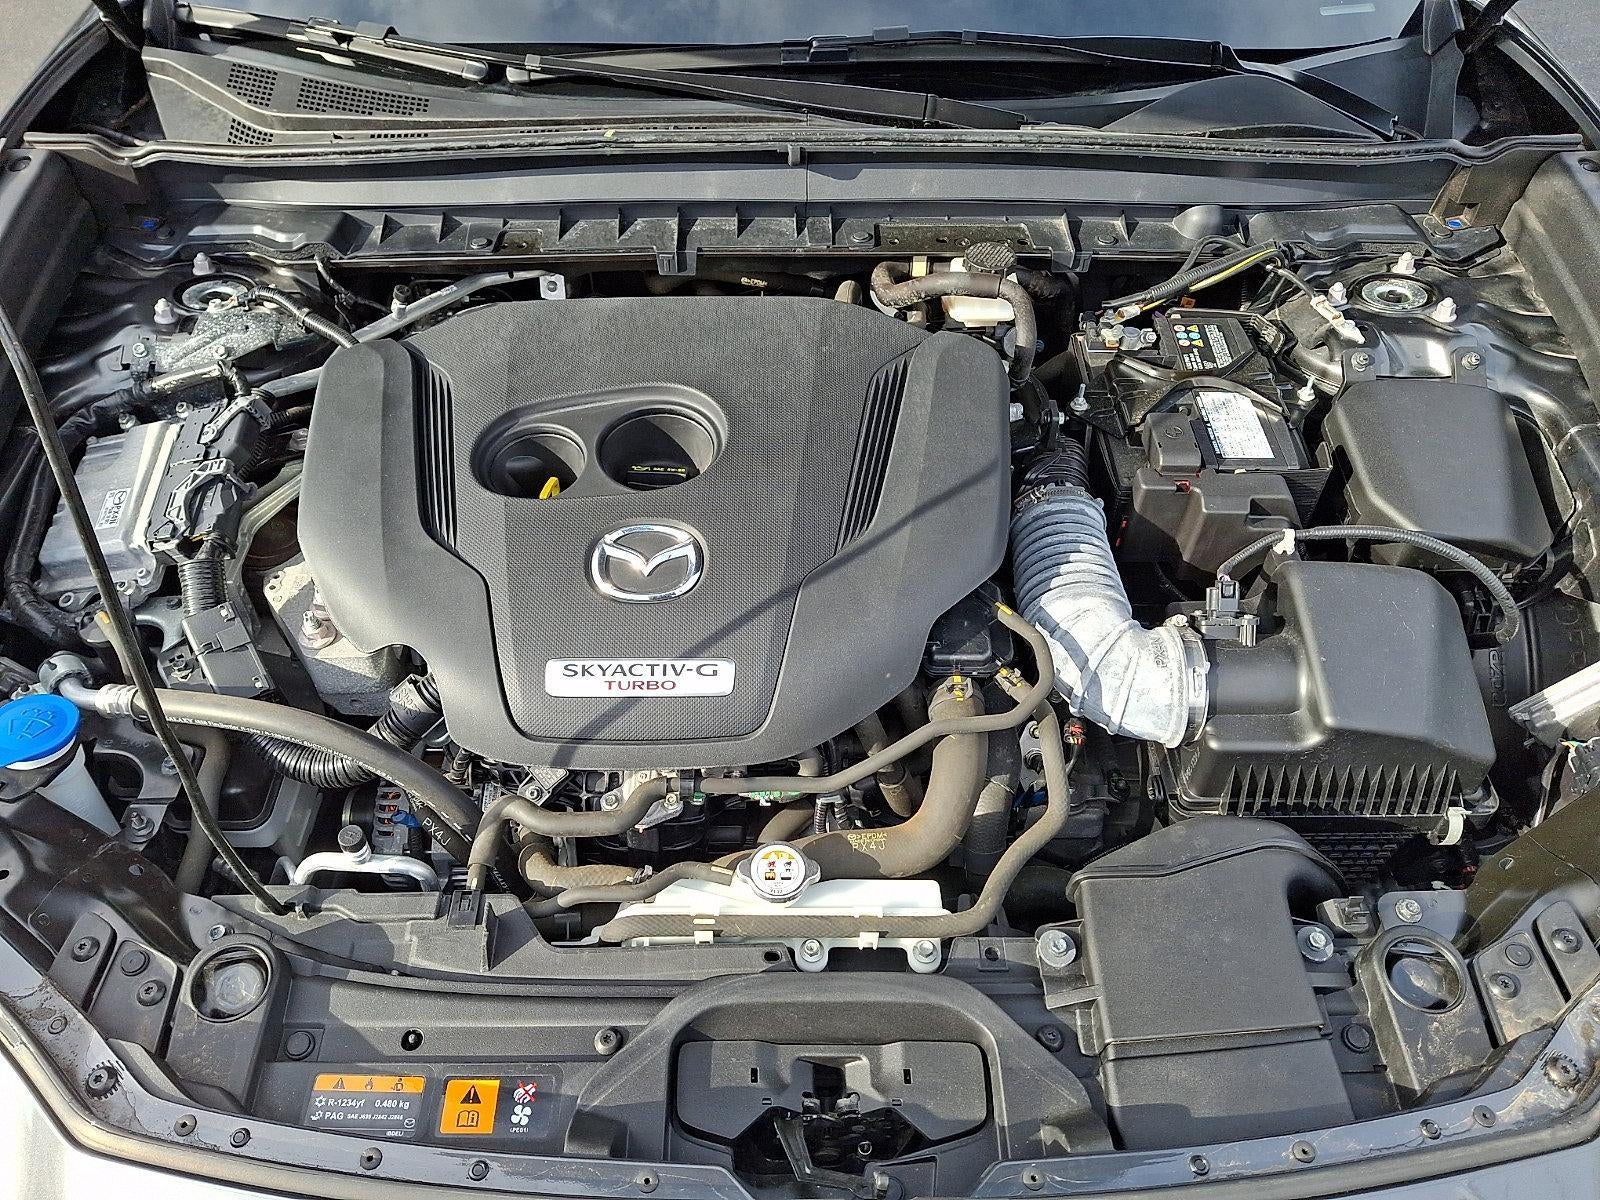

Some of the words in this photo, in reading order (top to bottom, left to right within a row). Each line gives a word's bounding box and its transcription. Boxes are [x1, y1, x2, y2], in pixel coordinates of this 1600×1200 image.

[562, 663, 718, 677] SKYACTIV-G
[604, 680, 677, 690] TURBO
[421, 816, 451, 846] PX4J
[852, 841, 886, 852] PX4J
[327, 1098, 366, 1109] R-1234yf
[398, 1100, 410, 1110] kg
[324, 1111, 344, 1120] PAG
